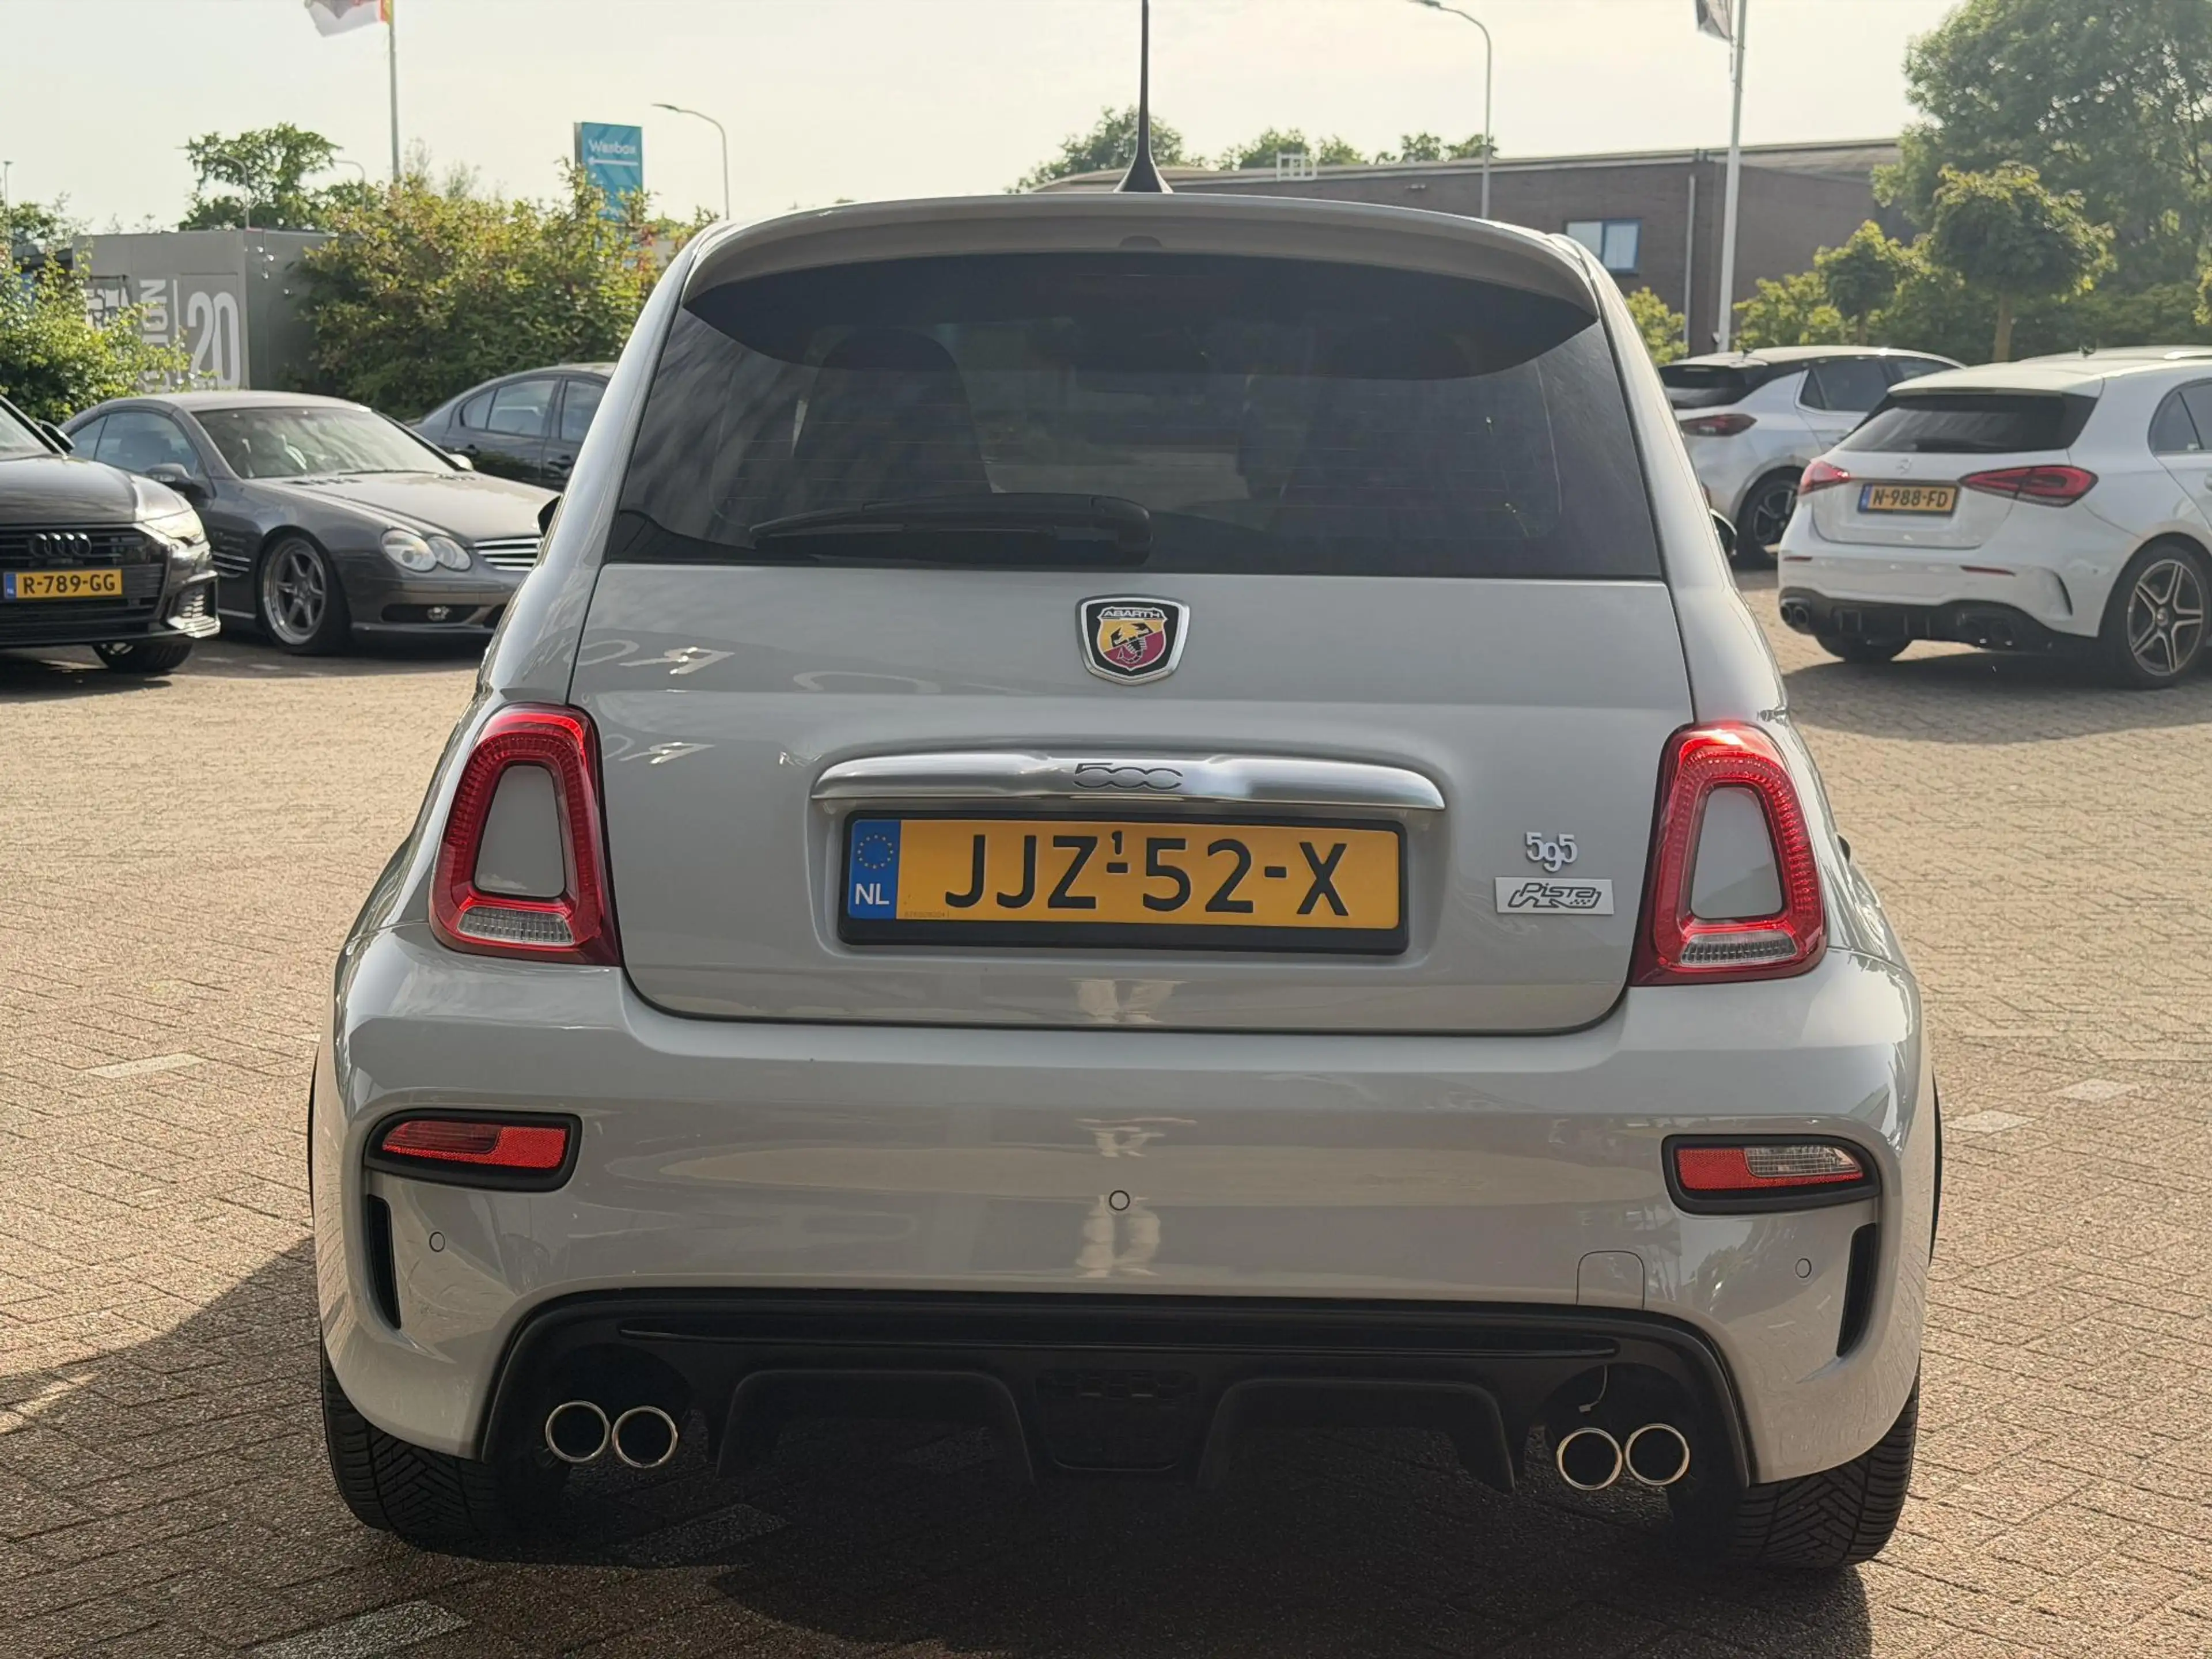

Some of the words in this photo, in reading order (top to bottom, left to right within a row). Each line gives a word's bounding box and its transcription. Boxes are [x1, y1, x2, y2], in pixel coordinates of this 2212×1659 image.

[187, 291, 240, 390] 20
[1873, 488, 1948, 507] N-988-FD
[23, 574, 115, 594] R-789-GG
[1104, 609, 1160, 618] ABARTH
[1073, 762, 1183, 790] 500
[1526, 831, 1578, 872] 595
[855, 883, 890, 906] NL
